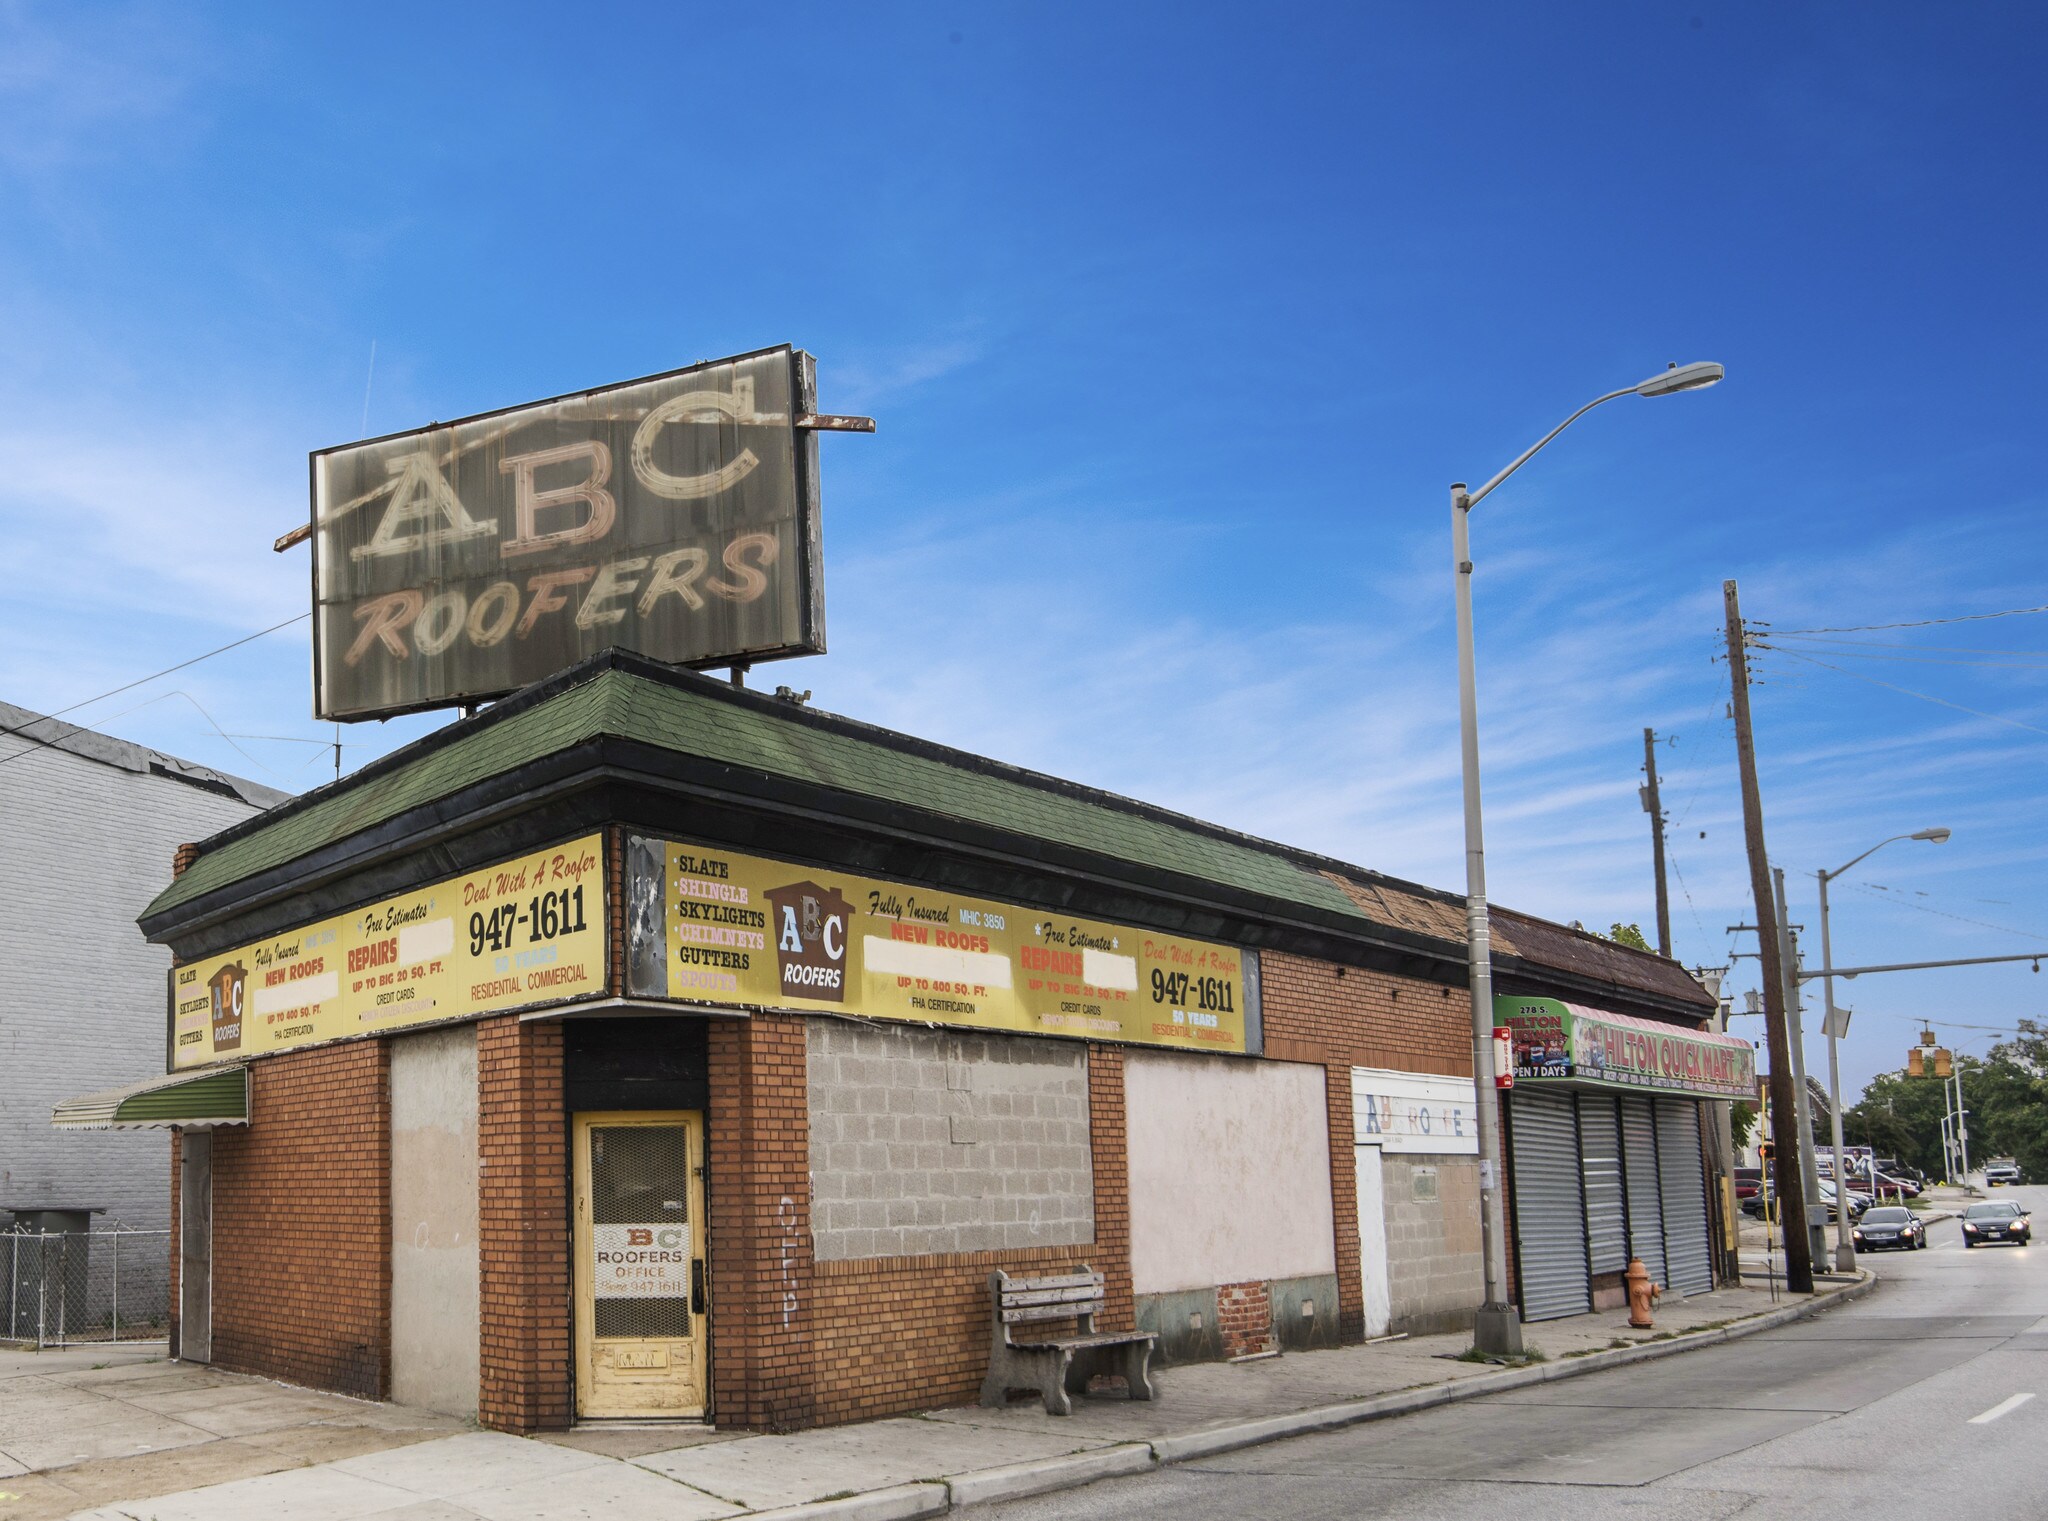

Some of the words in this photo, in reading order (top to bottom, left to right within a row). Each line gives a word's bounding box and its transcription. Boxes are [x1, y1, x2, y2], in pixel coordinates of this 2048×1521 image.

[351, 375, 760, 562] ABC
[344, 533, 779, 668] ROOFERS
[464, 878, 491, 906] Deal
[496, 865, 527, 896] With
[532, 859, 546, 889] A
[551, 850, 596, 883] Roofer
[680, 855, 728, 879] SLATE
[680, 877, 748, 904] SHINGLE
[680, 900, 765, 928] SKYLIGHTS
[869, 891, 903, 921] Fully
[907, 897, 949, 923] Insured
[365, 913, 383, 938] Free
[386, 903, 427, 931] Estimates
[469, 884, 587, 957] 947-1611
[780, 896, 844, 960] ABC
[960, 909, 981, 926] MHIC
[983, 913, 1005, 930] 3850
[680, 923, 764, 950] CHIMNEYS
[891, 923, 928, 944] NEW
[935, 930, 989, 953] ROOFS
[1044, 922, 1065, 944] Free
[1069, 926, 1111, 951] Estimates
[255, 948, 273, 971] Fully
[275, 938, 300, 961] Insured
[348, 937, 397, 974] REPAIRS
[680, 946, 750, 970] GUTTERS
[1021, 945, 1082, 977] REPAIRS
[1144, 940, 1166, 960] Deal
[1171, 945, 1192, 966] With
[1198, 951, 1206, 968] A
[1210, 951, 1237, 976] Roofer
[180, 969, 197, 985] SLATE
[265, 967, 286, 987] NEW
[290, 957, 324, 980] ROOFS
[353, 981, 363, 993] UP
[366, 977, 376, 989] TO
[380, 972, 394, 987] BIG
[397, 969, 407, 982] 20
[411, 965, 426, 979] SQ.
[430, 961, 444, 974] FT.
[471, 977, 522, 1001] RESIDENTIAL
[527, 963, 587, 990] COMMERCIAL
[681, 971, 736, 992] SPOUTS
[784, 963, 841, 988] ROOFERS
[213, 974, 242, 1020] ABC
[377, 991, 395, 1006] CREDIT
[397, 987, 415, 1002] CARDS
[898, 976, 911, 988] UP
[916, 979, 928, 990] TO
[932, 981, 950, 992] 400
[955, 984, 970, 996] SQ.
[974, 986, 987, 997] FT.
[1029, 979, 1042, 990] UP
[1047, 981, 1059, 993] TO
[1064, 984, 1079, 995] BIG
[1084, 986, 1094, 997] 20
[1098, 988, 1112, 999] SQ.
[1116, 990, 1128, 1001] FT.
[1151, 968, 1234, 1013] 947-1611
[180, 997, 209, 1015] SKYLIGHTS
[268, 1014, 275, 1025] UP
[277, 1012, 284, 1022] TO
[286, 1009, 298, 1020] 400
[300, 1007, 310, 1018] SQ.
[313, 1004, 321, 1015] FT.
[912, 996, 925, 1008] FHA
[928, 998, 975, 1014] CERTIFICATION
[1061, 1001, 1081, 1013] CREDIT
[1083, 1004, 1101, 1016] CARDS
[1520, 1006, 1537, 1014] 278
[1172, 1010, 1184, 1023] 50
[1187, 1012, 1218, 1028] YEARS
[1504, 1015, 1562, 1028] HILTON
[180, 1030, 203, 1046] GUTTERS
[215, 1023, 240, 1042] ROOFERS
[283, 1024, 314, 1039] CERTIFICATION
[1152, 1023, 1192, 1038] RESIDENTIAL
[1197, 1028, 1235, 1043] COMMERCIAL
[1511, 1029, 1536, 1040] UICK
[1536, 1029, 1561, 1041] MART
[1603, 1026, 1659, 1074] HILTON
[1661, 1037, 1700, 1079] QUICK
[1702, 1045, 1735, 1084] MART
[1513, 1066, 1531, 1077] PEN
[1533, 1066, 1539, 1077] 7
[1541, 1066, 1566, 1077] DAYS
[598, 1251, 682, 1263] ROOFERS
[615, 1266, 665, 1278] OFFICE
[631, 1281, 654, 1292] 947
[659, 1281, 681, 1292] 1611
